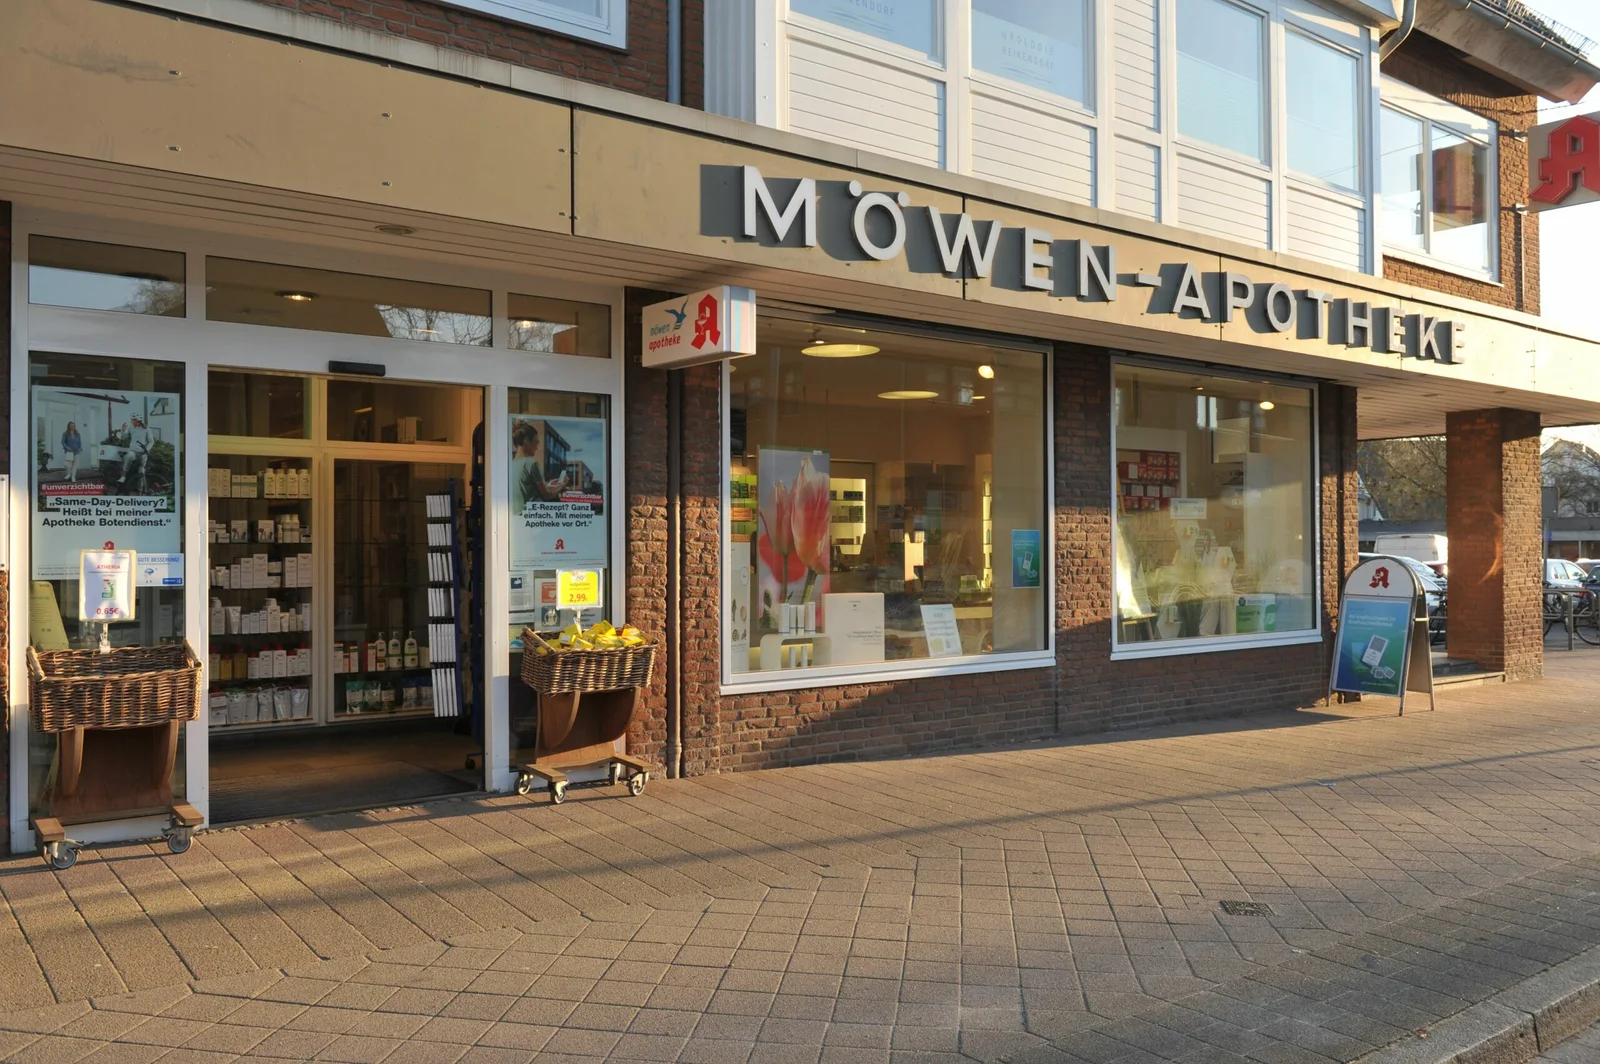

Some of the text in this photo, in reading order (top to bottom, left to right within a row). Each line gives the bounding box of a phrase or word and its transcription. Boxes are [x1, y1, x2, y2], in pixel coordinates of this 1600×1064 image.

[740, 164, 1466, 365] MÖWEN-APOTHEKE
[648, 334, 681, 352] apotheke
[41, 482, 105, 491] #unverzichtbar
[62, 507, 153, 517] Heißt bei meiner
[523, 511, 553, 519] einfach.
[42, 518, 96, 528] Apotheke
[525, 520, 560, 528] Apotheke
